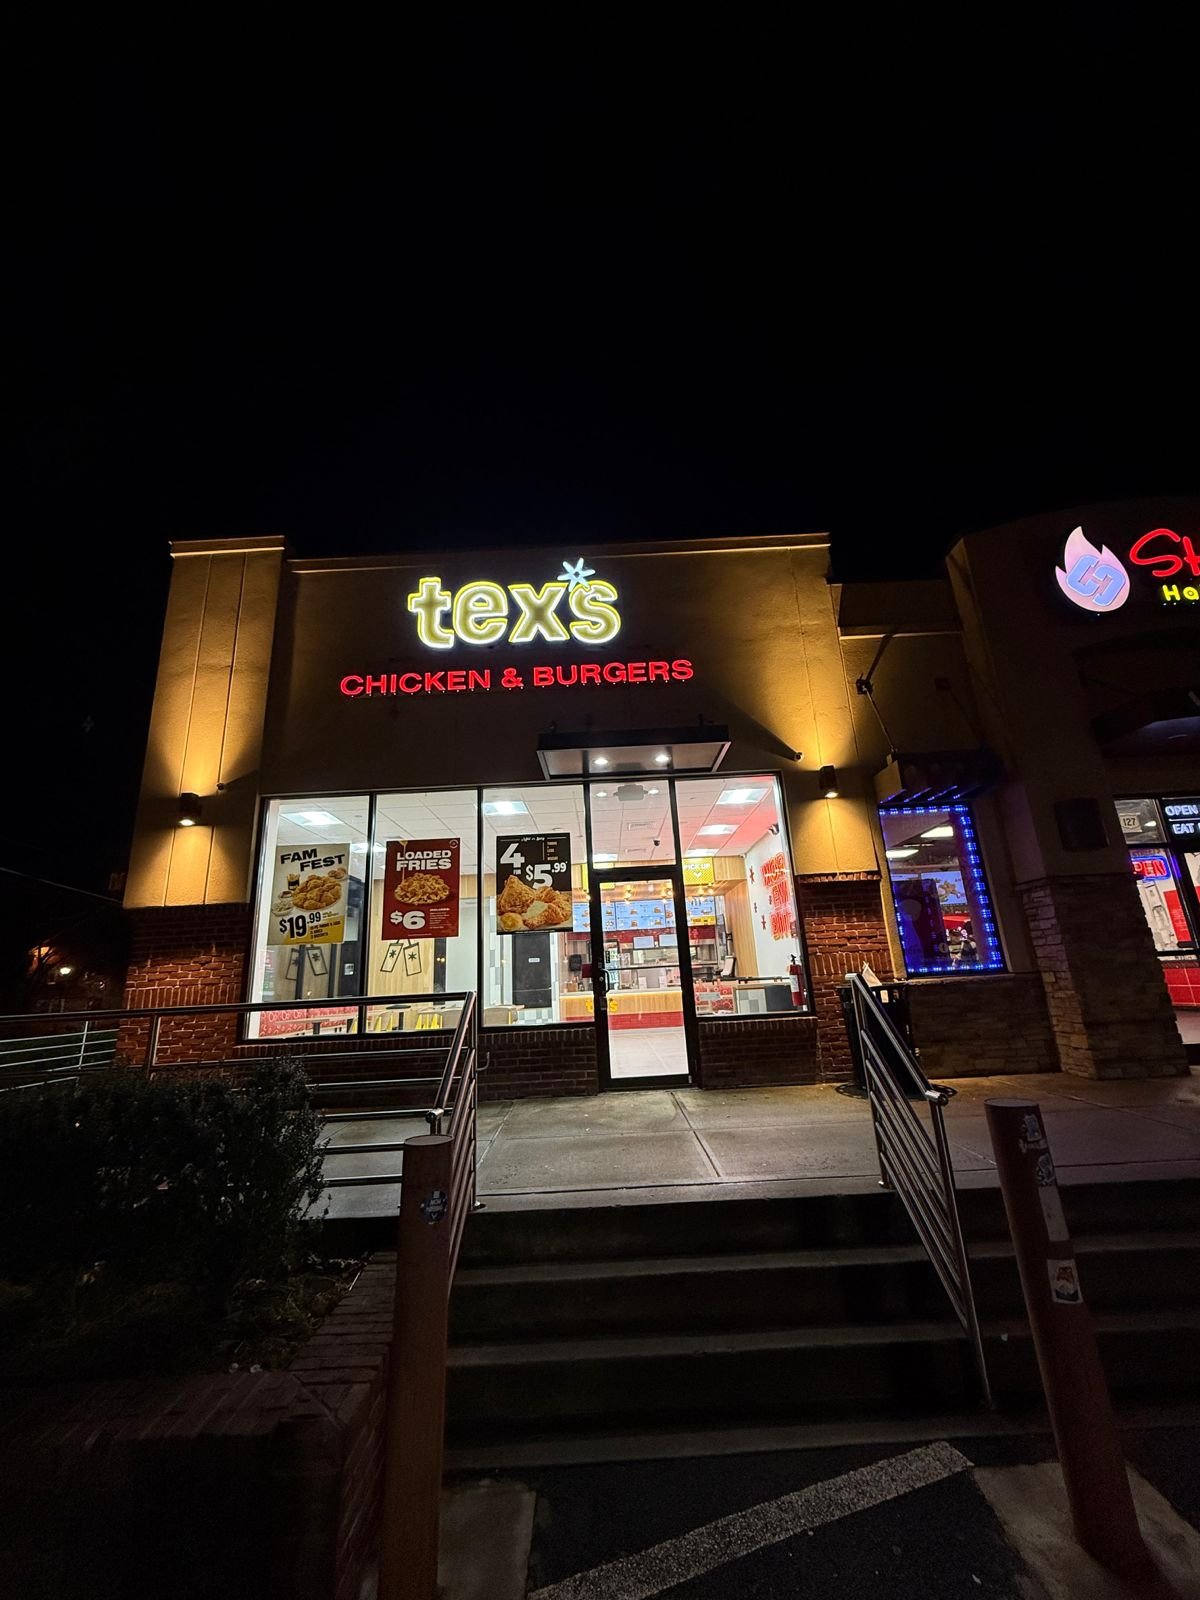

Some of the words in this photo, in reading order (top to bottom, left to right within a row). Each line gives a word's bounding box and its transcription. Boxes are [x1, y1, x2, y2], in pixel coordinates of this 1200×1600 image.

[340, 670, 491, 695] CHICKEN
[502, 667, 523, 688] &
[533, 659, 694, 687] BURGERS
[1164, 805, 1199, 816] OPEN
[1123, 817, 1137, 827] 127
[1172, 823, 1195, 834] EAT
[280, 848, 318, 864] FAM
[300, 854, 345, 872] FEST
[396, 850, 452, 860] LOADED
[500, 843, 525, 868] 4
[396, 859, 452, 871] FRIES
[1132, 859, 1168, 877] PEN
[279, 912, 321, 938] $19.99
[390, 910, 426, 929] $6
